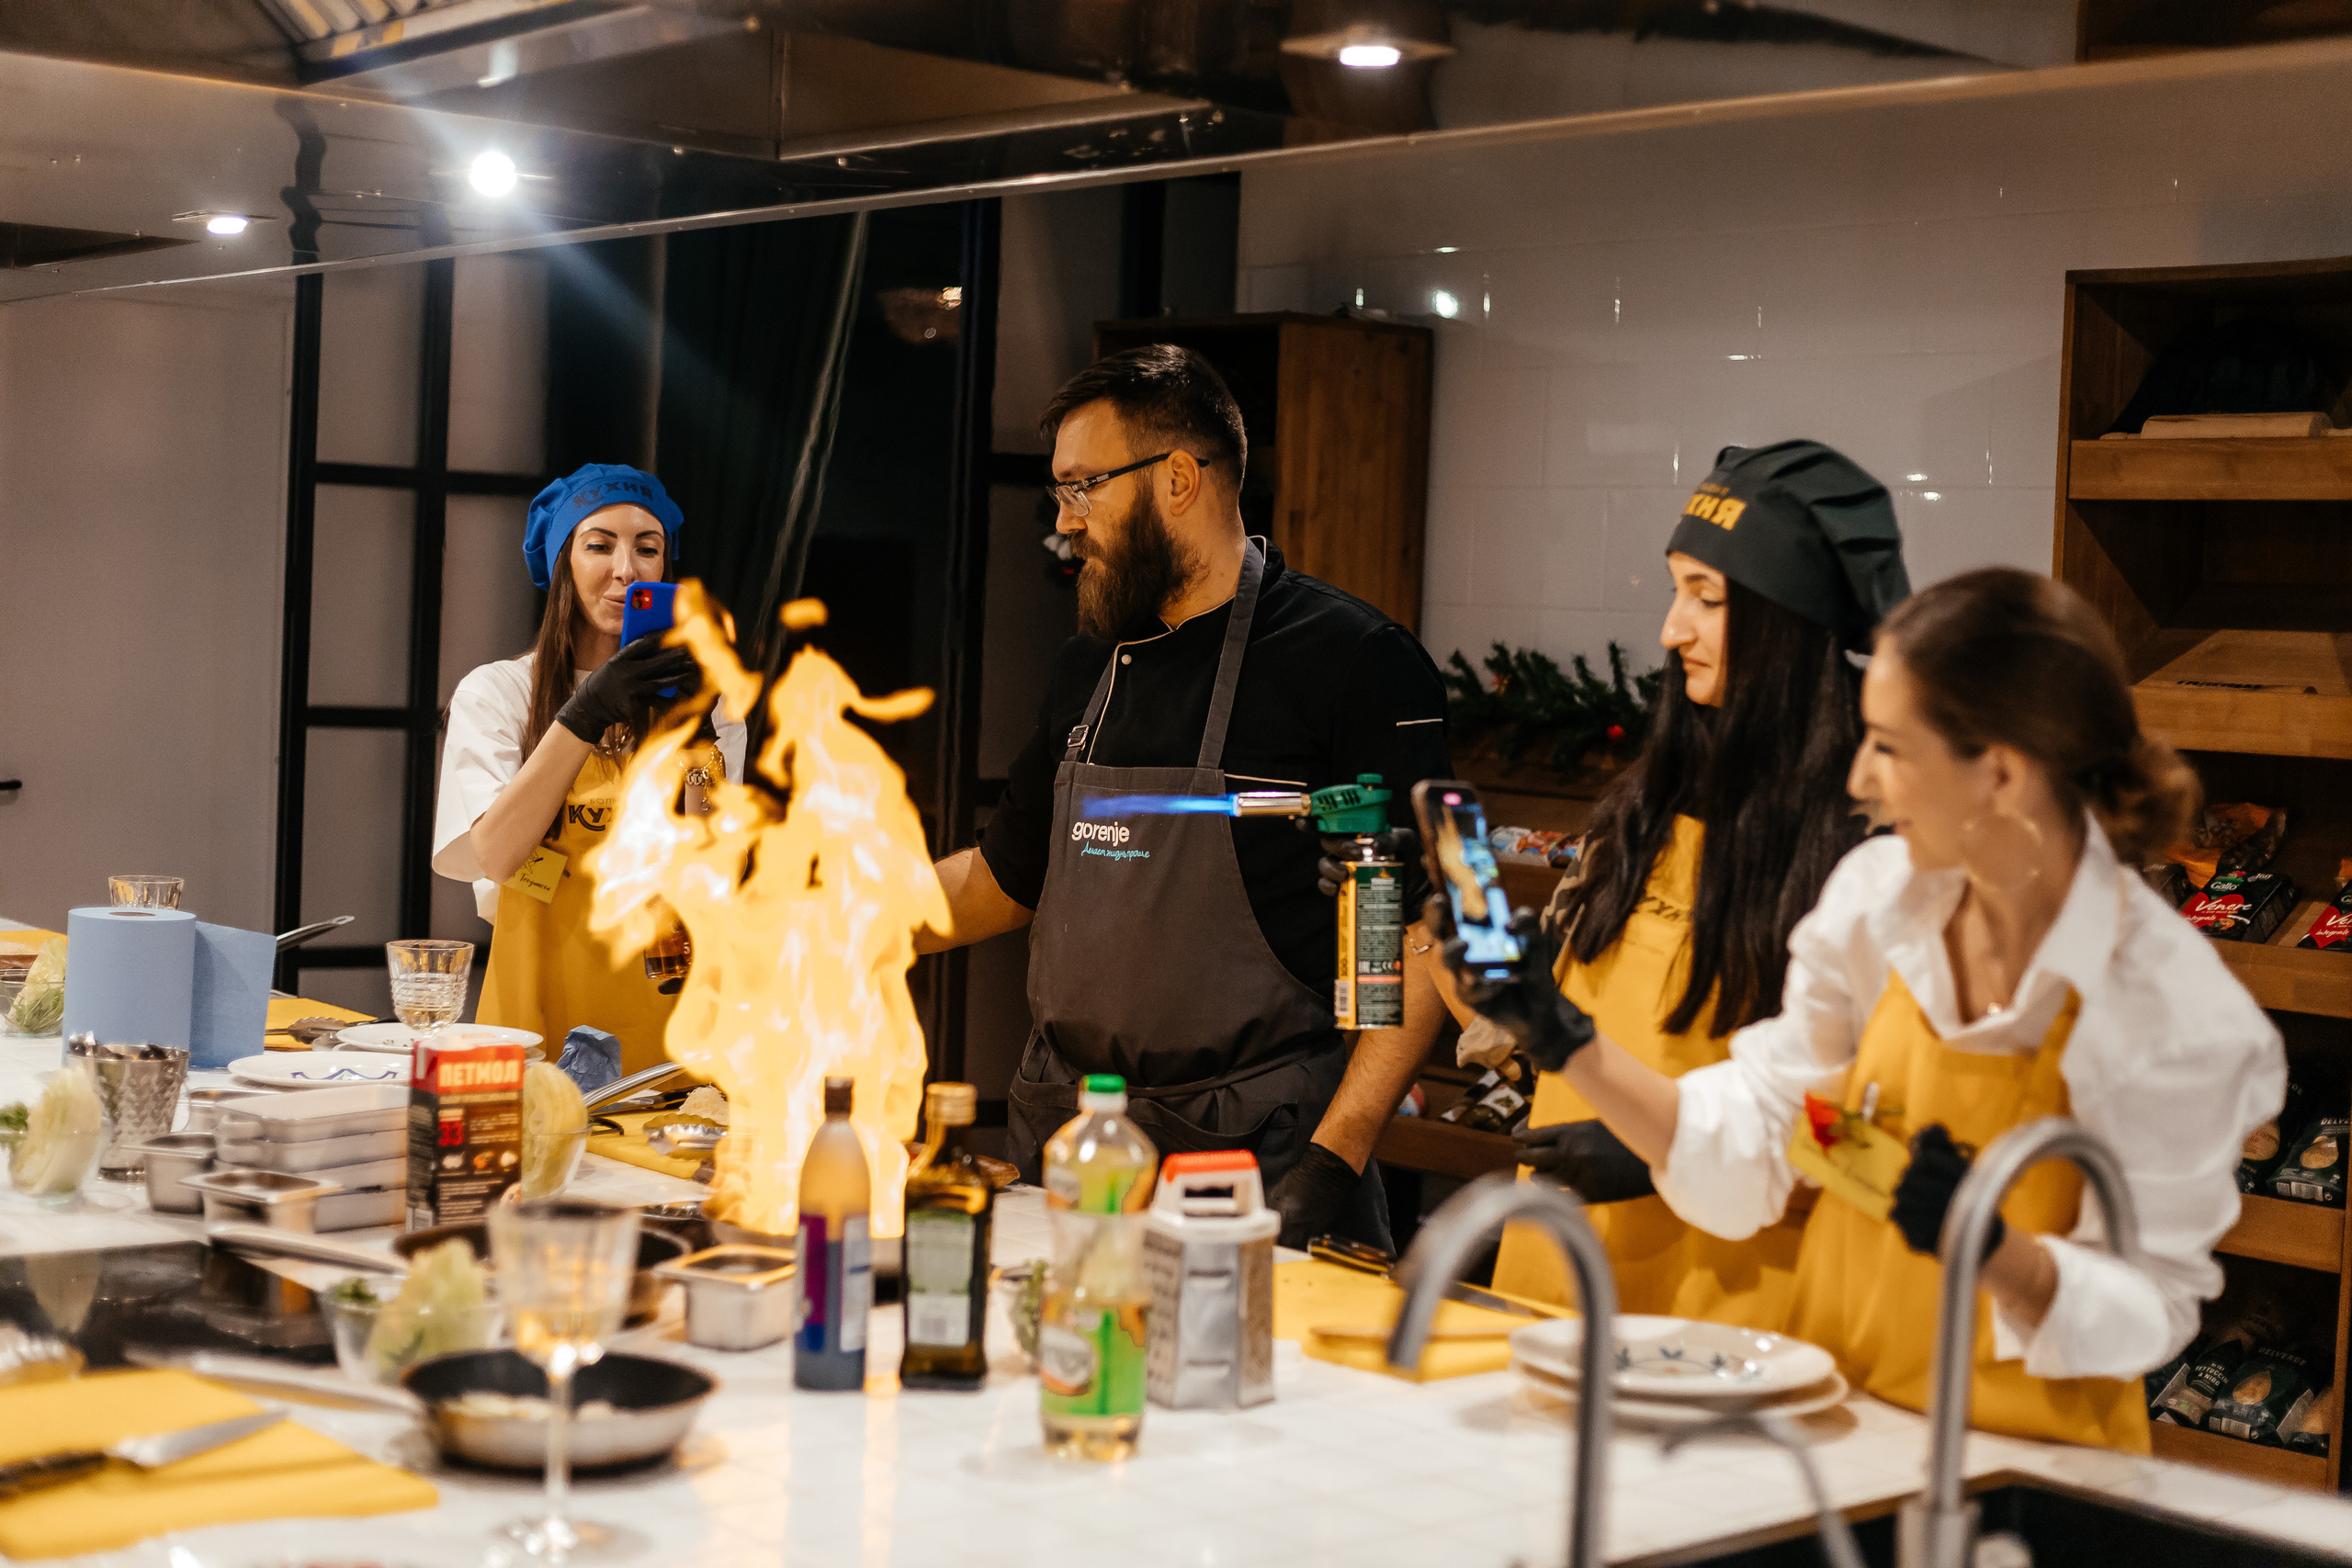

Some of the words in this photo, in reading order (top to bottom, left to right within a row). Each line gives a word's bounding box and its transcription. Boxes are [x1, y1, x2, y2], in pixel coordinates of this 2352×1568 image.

[572, 481, 653, 510] КУХНЯ
[1071, 821, 1130, 847] gorenje
[2210, 881, 2238, 891] Gallo
[2195, 898, 2253, 912] Venere
[438, 1059, 520, 1088] ПЕТМОЛ
